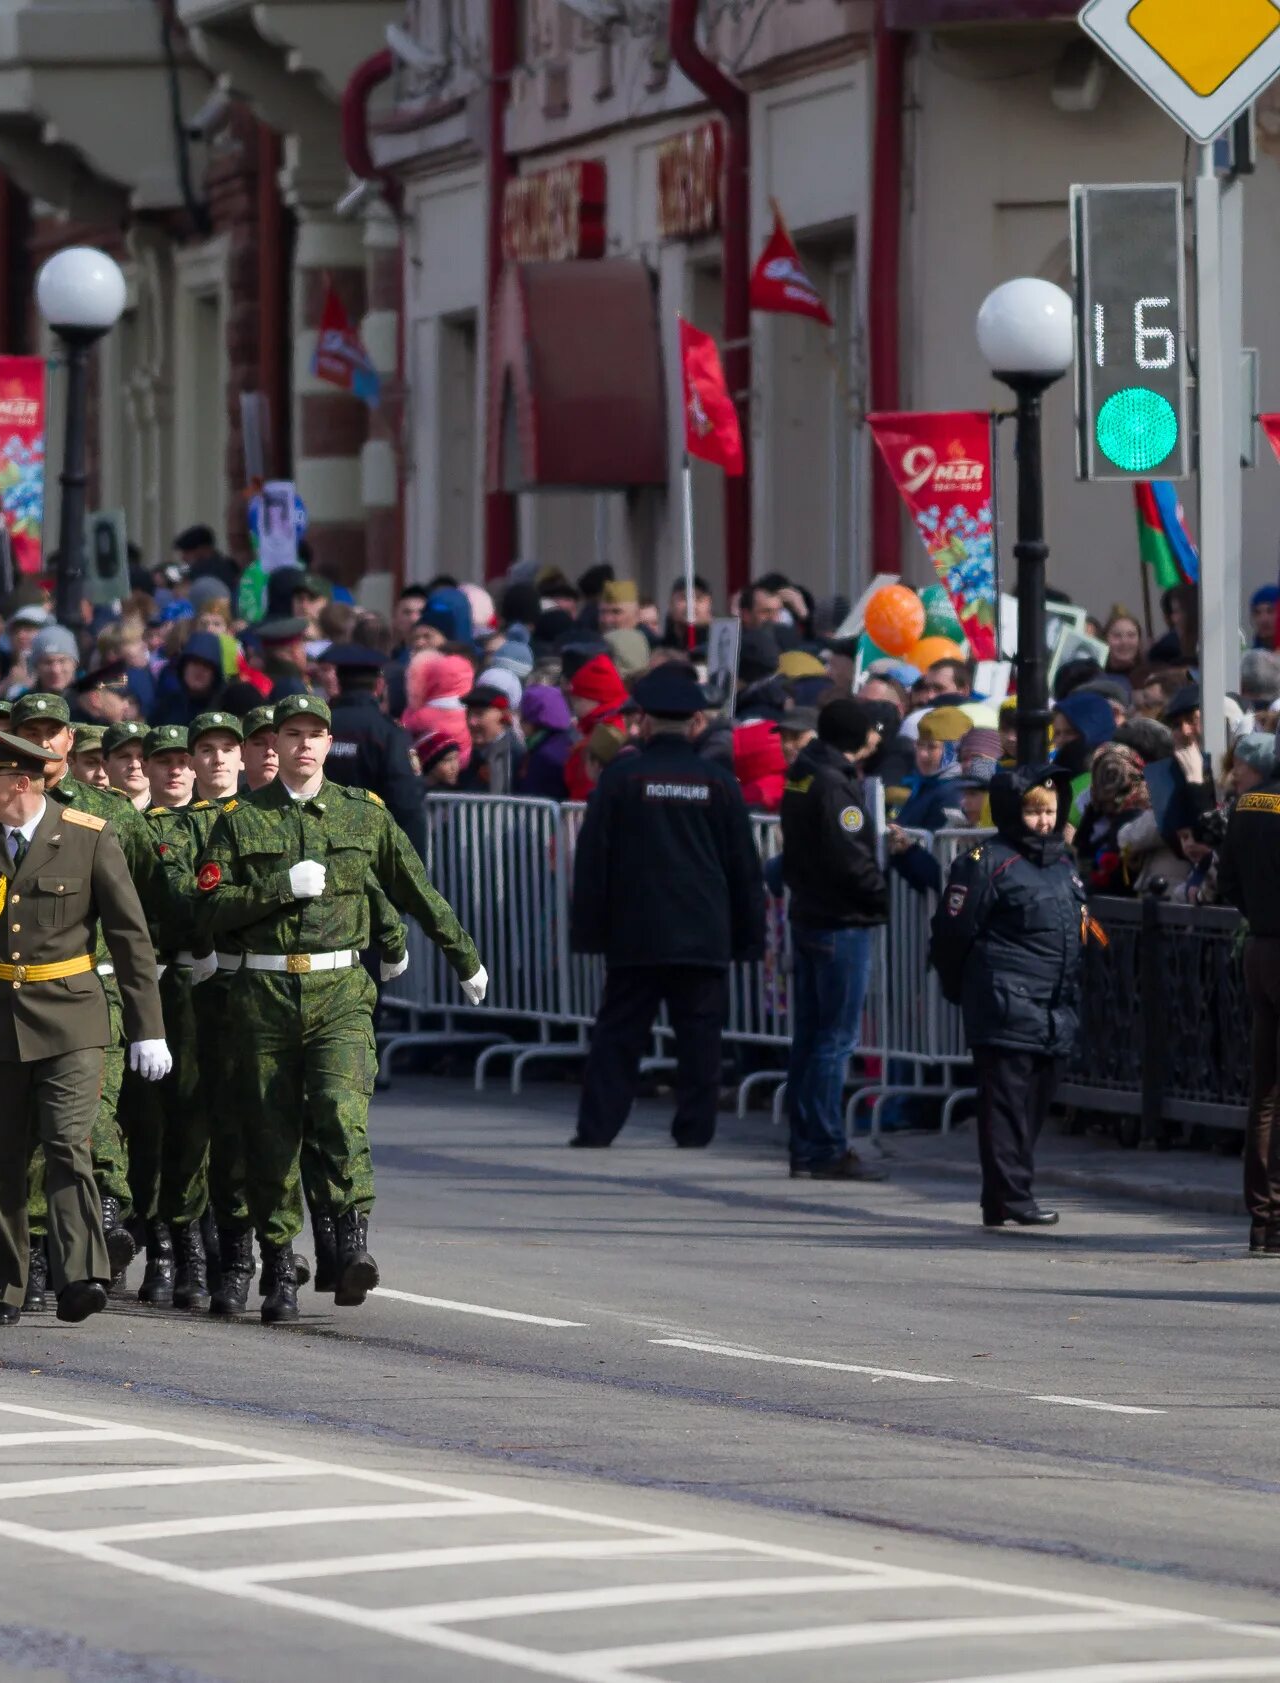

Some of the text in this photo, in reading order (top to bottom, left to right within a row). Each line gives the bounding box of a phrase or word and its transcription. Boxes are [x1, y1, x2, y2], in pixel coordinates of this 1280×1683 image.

[1095, 297, 1175, 369] 16
[902, 444, 937, 494] 9
[646, 783, 709, 800] ПОЛИЦИЯ
